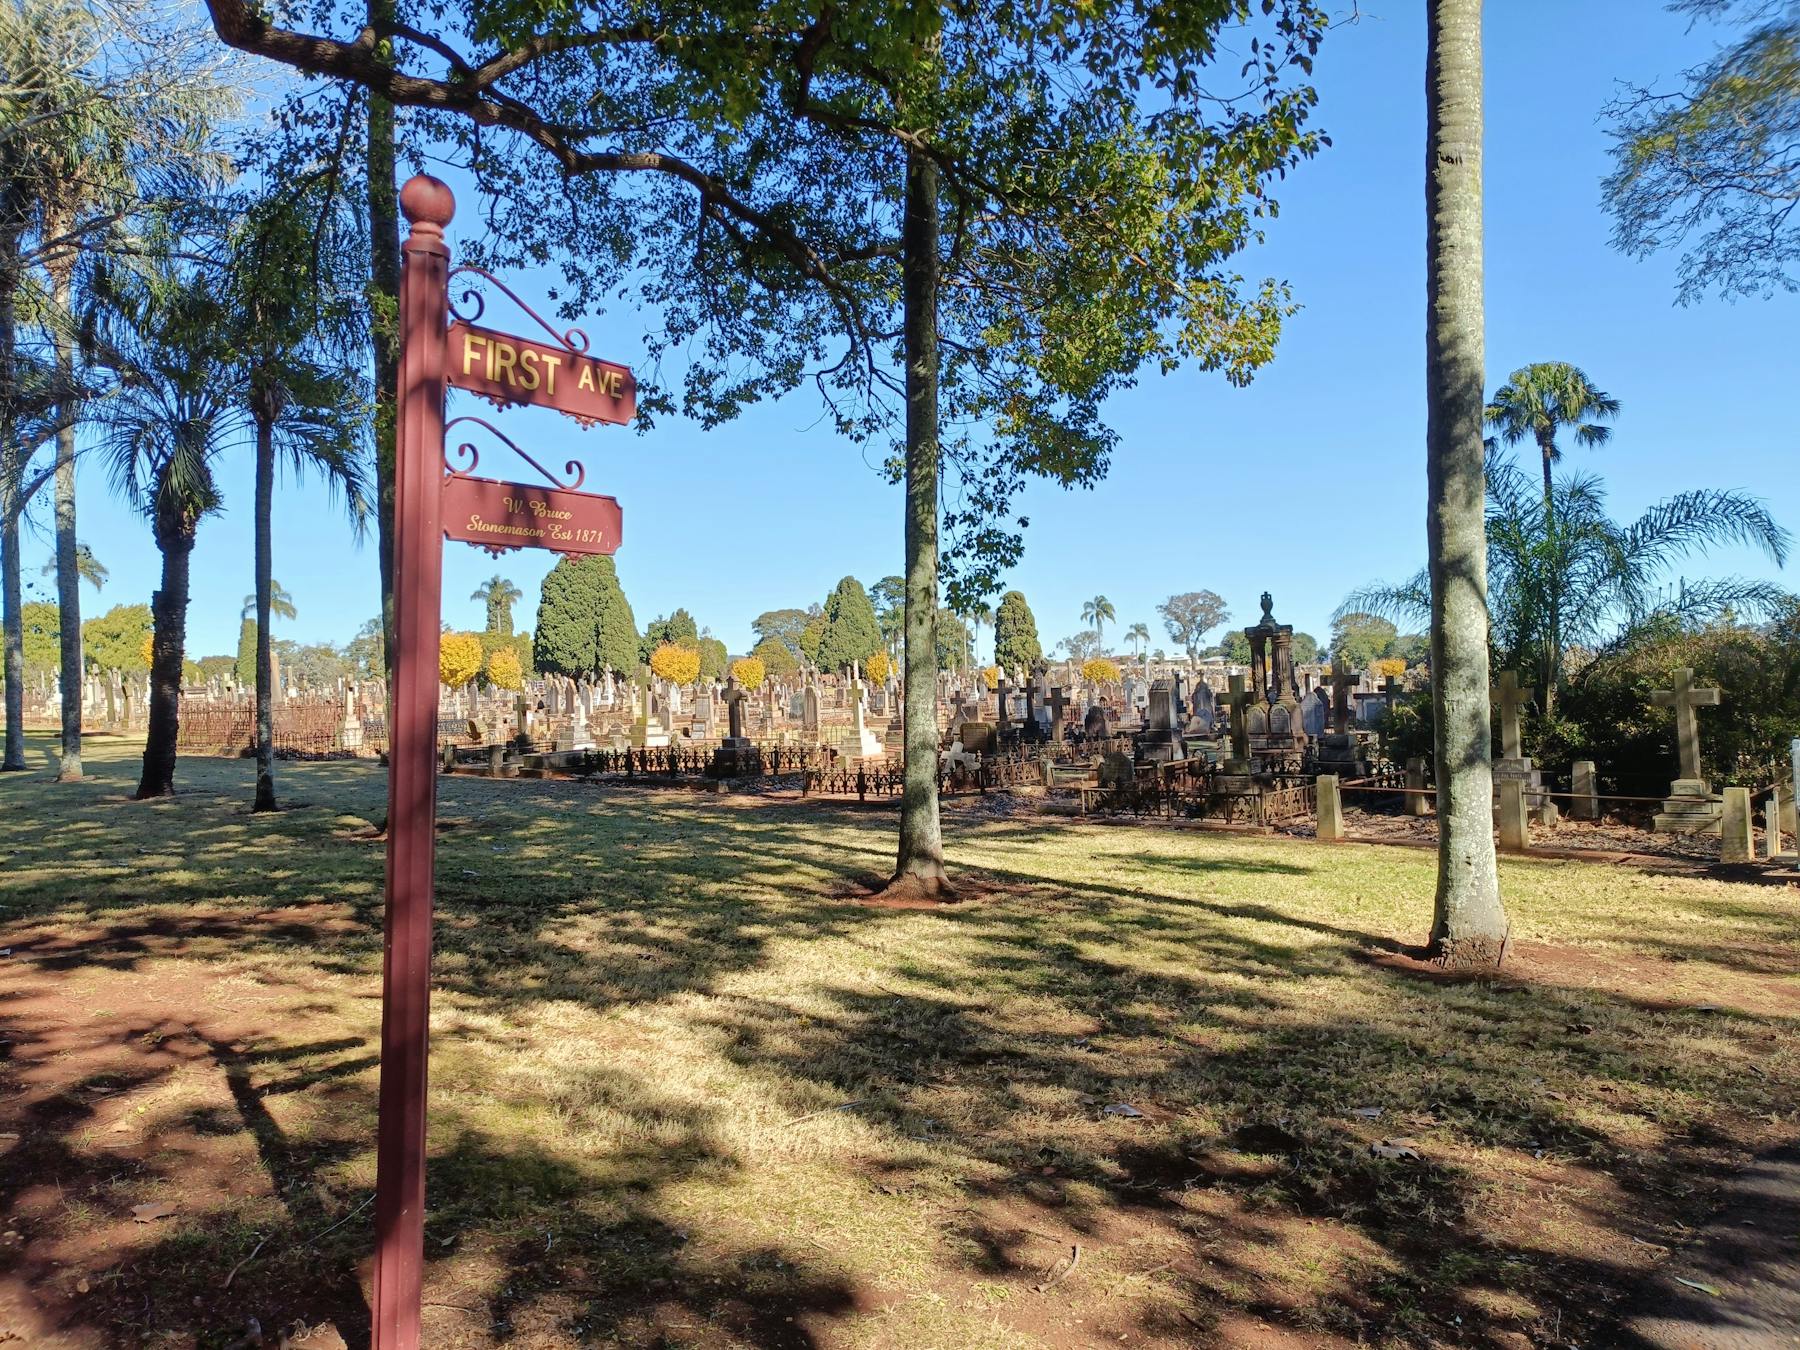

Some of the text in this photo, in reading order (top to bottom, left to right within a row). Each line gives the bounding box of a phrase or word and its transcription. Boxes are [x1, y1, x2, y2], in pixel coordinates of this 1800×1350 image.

[463, 333, 624, 399] FIRST AVE
[503, 497, 573, 521] W. Bruce
[466, 514, 603, 544] Stonemason Est 1871
